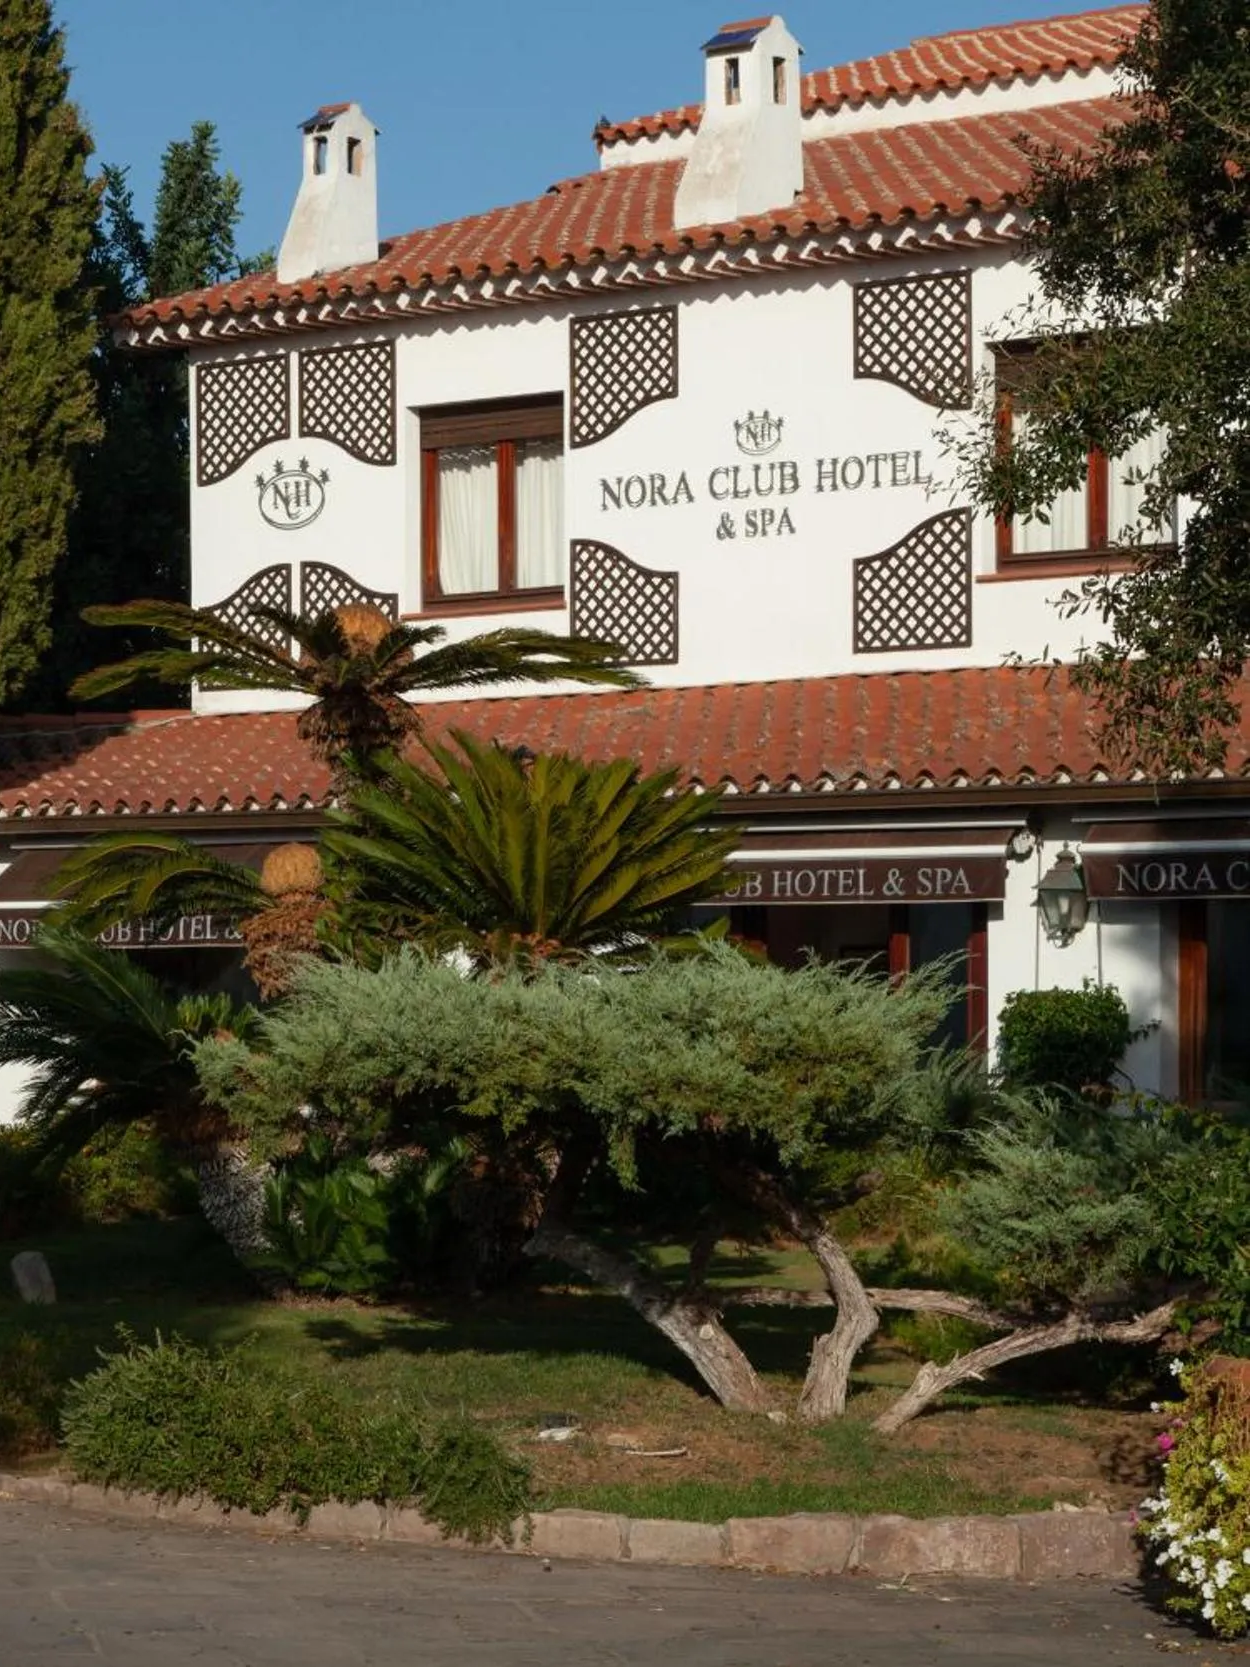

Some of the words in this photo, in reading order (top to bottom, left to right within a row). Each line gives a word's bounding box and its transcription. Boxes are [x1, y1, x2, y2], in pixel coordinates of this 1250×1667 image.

[600, 470, 695, 511] NORA
[708, 461, 801, 500] CLUB
[816, 450, 933, 492] HOTEL
[715, 511, 737, 540] &
[745, 506, 797, 538] SPA
[772, 868, 875, 897] HOTEL
[882, 867, 906, 897] &
[916, 866, 975, 896] SPA
[1115, 862, 1218, 892] NORA
